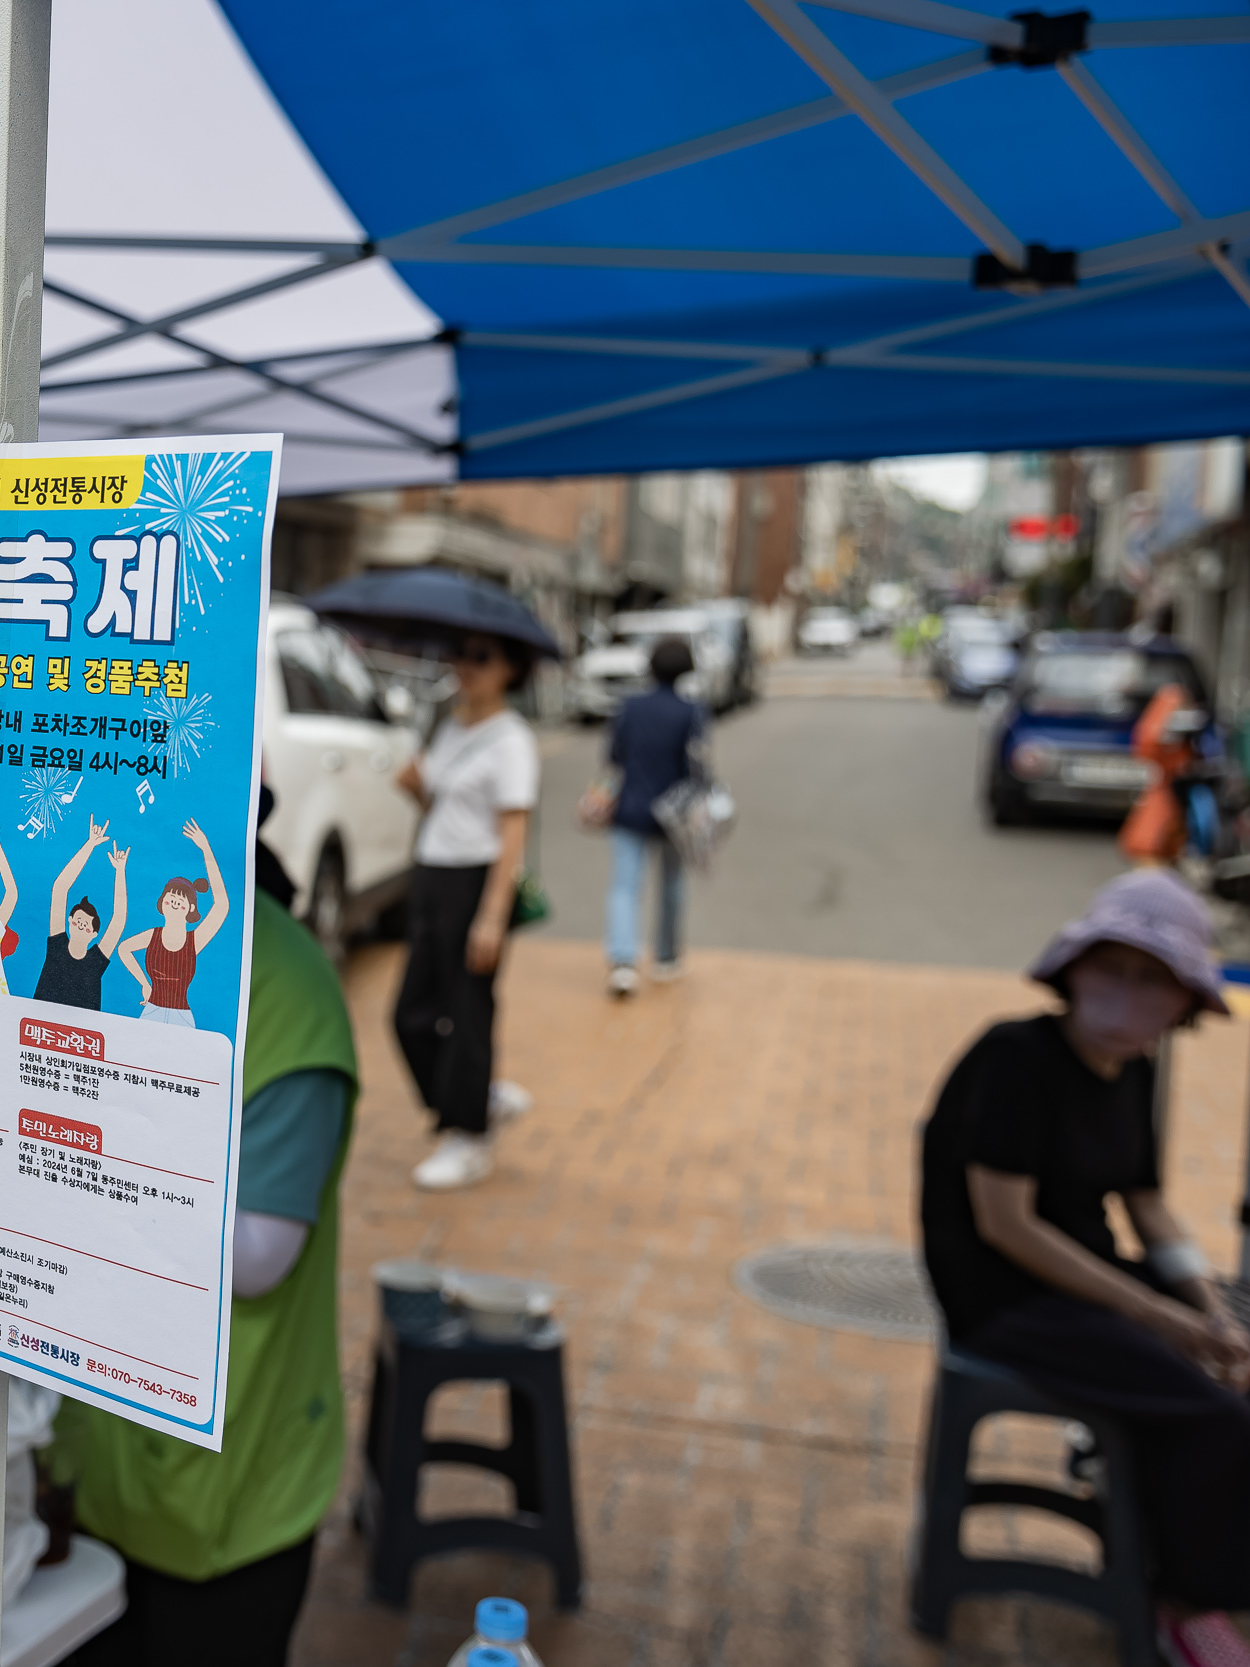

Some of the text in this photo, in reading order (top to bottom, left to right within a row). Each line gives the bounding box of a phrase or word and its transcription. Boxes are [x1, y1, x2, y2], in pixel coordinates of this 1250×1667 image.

[11, 475, 127, 506] 신성전통시장
[46, 656, 70, 694] 및
[83, 659, 190, 699] 경품추첨
[31, 713, 170, 745] 포차조개구이앞
[31, 745, 84, 772] 금요일
[89, 751, 168, 780] 4시~8시
[24, 1023, 101, 1057] 맥주교환권
[20, 1050, 200, 1098] 시장내 상인회가입점포영수증 지참시 맥주무료제공
[20, 1062, 61, 1081] 5천원영수증
[73, 1073, 99, 1089] 맥주1잔
[20, 1074, 60, 1092] 1만원영수증
[72, 1085, 99, 1101] 맥주2잔
[22, 1117, 99, 1150] 주민노래자랑
[41, 1146, 55, 1159] 장기
[59, 1150, 67, 1163] 및
[18, 1163, 40, 1179] 본무대
[44, 1170, 58, 1184] 진출
[108, 1188, 138, 1206] 상품수여
[19, 1152, 33, 1165] 예심
[43, 1158, 67, 1175] 2024년
[71, 1166, 83, 1179] 6월
[86, 1170, 98, 1183] 7일
[101, 1173, 138, 1194] 동주민센터
[142, 1185, 158, 1199] 오후
[162, 1190, 194, 1209] 1시~3시
[6, 1270, 55, 1295] 구매영수증지참
[37, 1257, 67, 1276] 조기마감)
[20, 1333, 80, 1367] 신성전통시장
[86, 1358, 197, 1408] 문의:070-7543-7358
